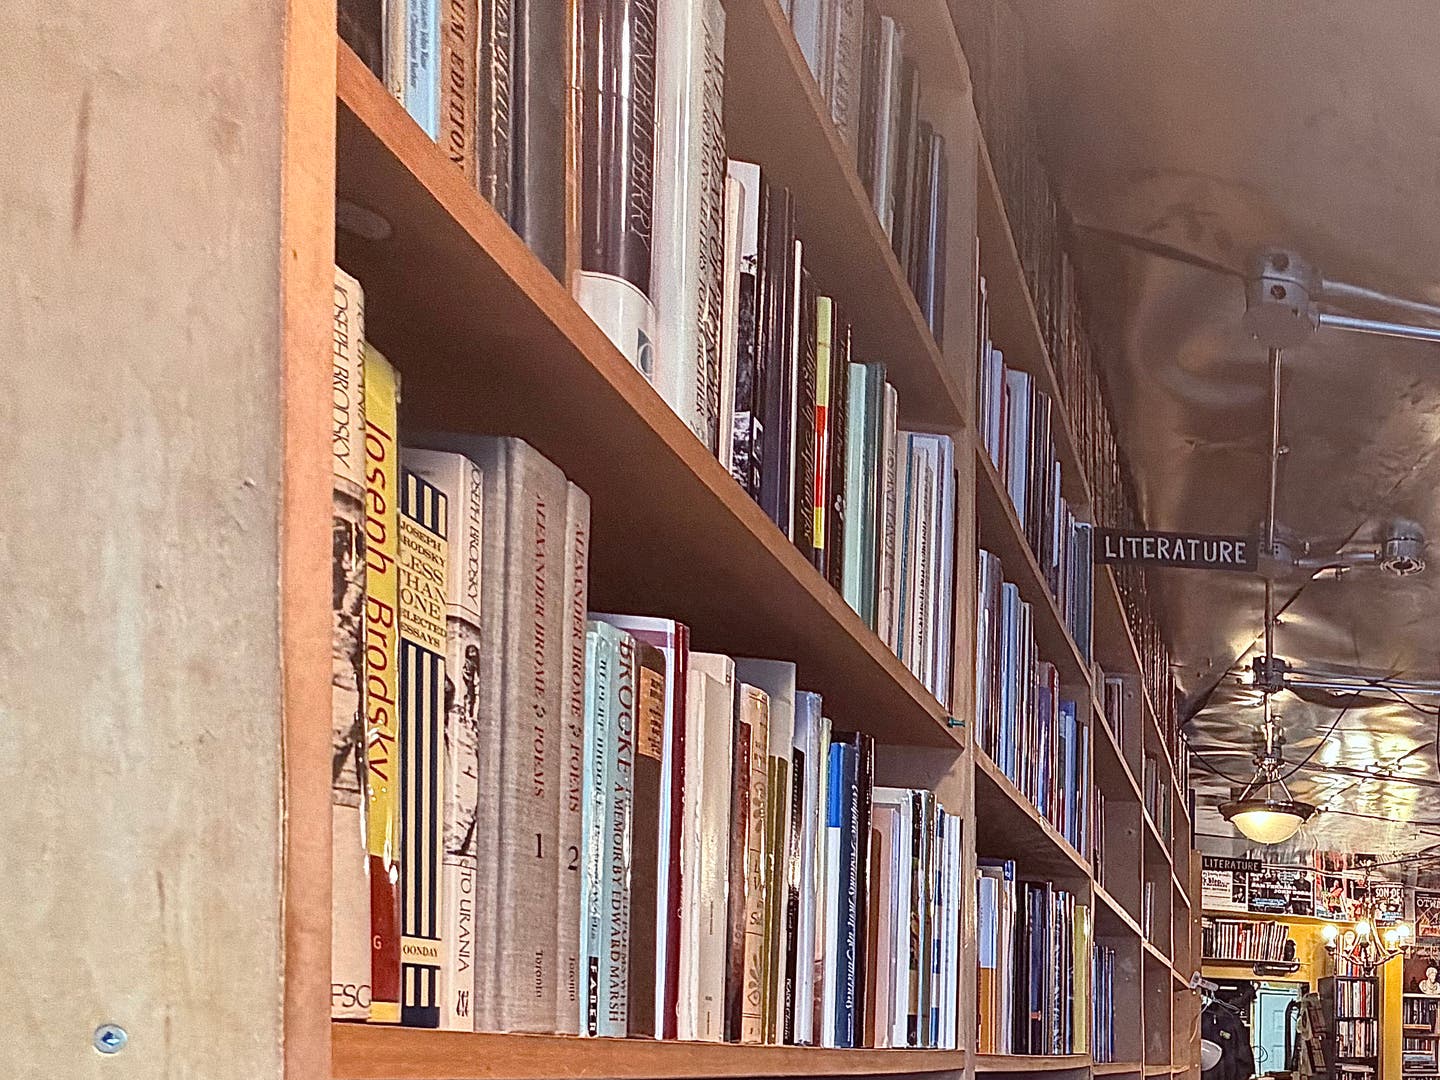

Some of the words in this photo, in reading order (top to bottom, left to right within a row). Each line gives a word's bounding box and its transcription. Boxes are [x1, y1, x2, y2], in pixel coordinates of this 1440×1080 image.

[450, 51, 465, 171] EDITION
[630, 143, 652, 252] BERRY
[332, 284, 350, 362] JOSEPH
[696, 335, 706, 417] MOTHER
[332, 363, 350, 470] BRODSKY
[366, 419, 394, 576] Joseph
[468, 466, 482, 525] JOSEPH
[401, 521, 442, 552] JOSEPH
[468, 526, 482, 607] BRODSKY
[534, 495, 546, 618] ALEXANDER
[1105, 535, 1247, 564] LITERATURE
[401, 588, 442, 621] ONE
[570, 522, 584, 641] ALEXANDER
[366, 597, 394, 784] Brodsky
[534, 621, 546, 699] BROME
[570, 645, 584, 718] BROME
[617, 640, 633, 775] BROOKE
[534, 726, 546, 798] POEMS
[570, 741, 584, 814] POEMS
[611, 781, 624, 794] A
[567, 845, 578, 871] 2
[611, 797, 624, 863] MEMOIR
[1204, 858, 1260, 871] LITERATURE
[460, 870, 472, 895] TO
[611, 864, 624, 887] BY
[460, 899, 472, 974] URANIA
[611, 889, 624, 964] EDWARD
[331, 984, 372, 1009] FSG
[535, 951, 543, 999] Toronto
[567, 957, 578, 1002] Toronto
[589, 965, 598, 1031] FABER
[611, 965, 624, 1023] MARSH
